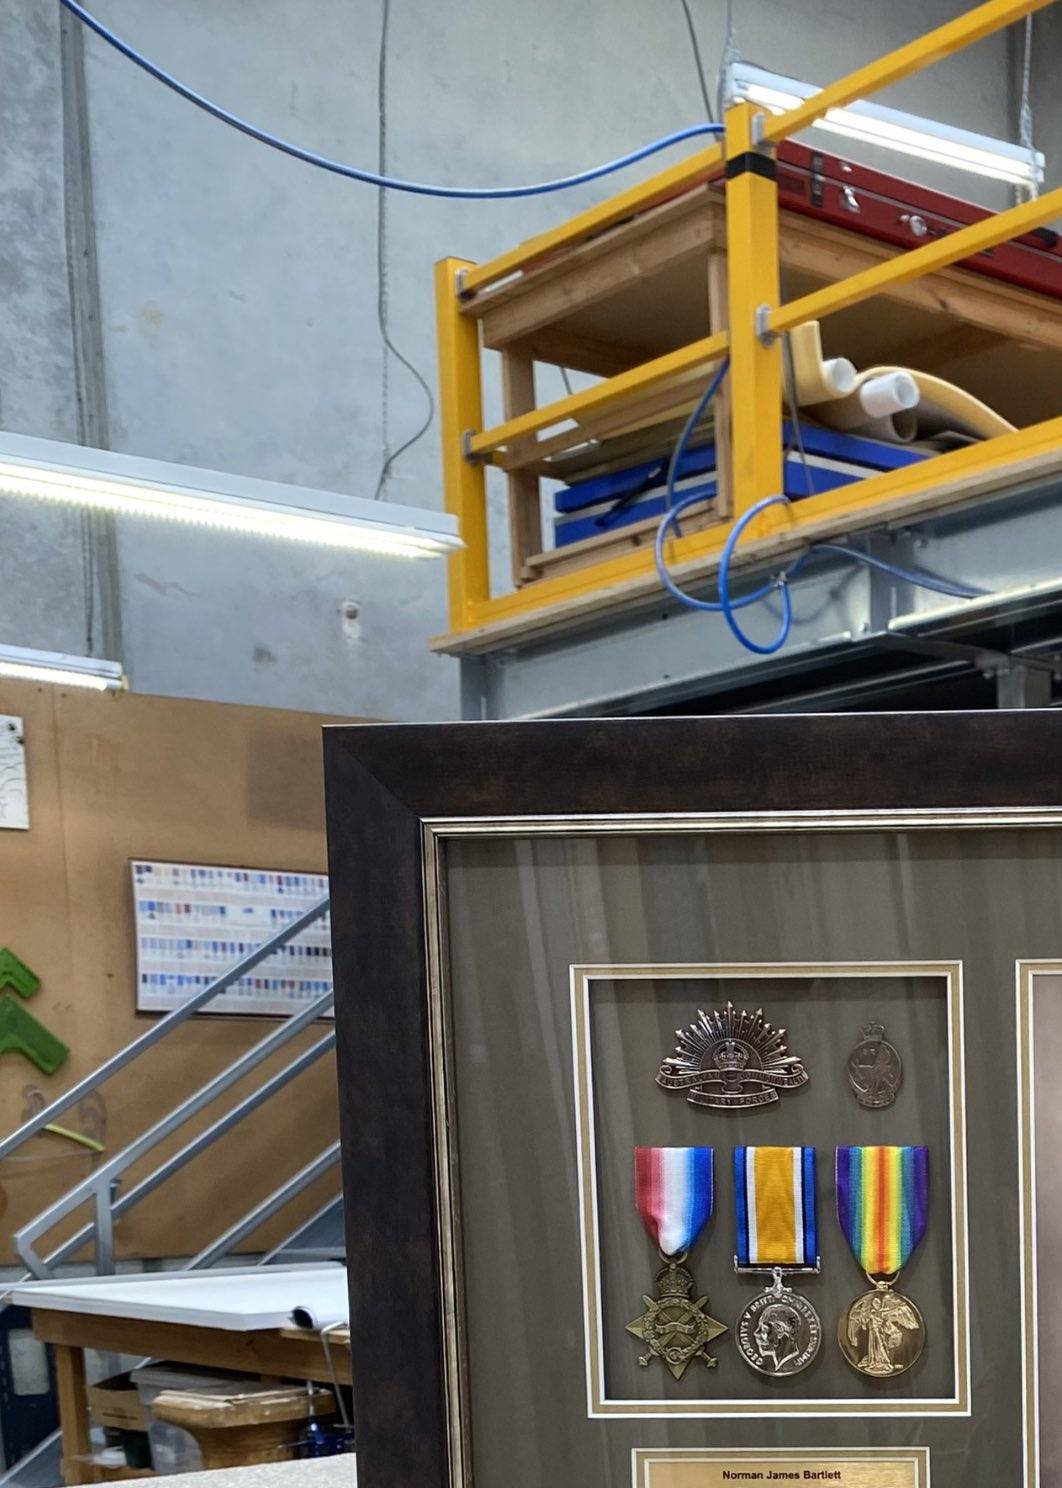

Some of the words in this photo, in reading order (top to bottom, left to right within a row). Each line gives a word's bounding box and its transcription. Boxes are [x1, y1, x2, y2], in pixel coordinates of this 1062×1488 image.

[722, 1470, 764, 1480] Norman
[766, 1470, 800, 1480] James
[803, 1470, 842, 1480] Bartlett
